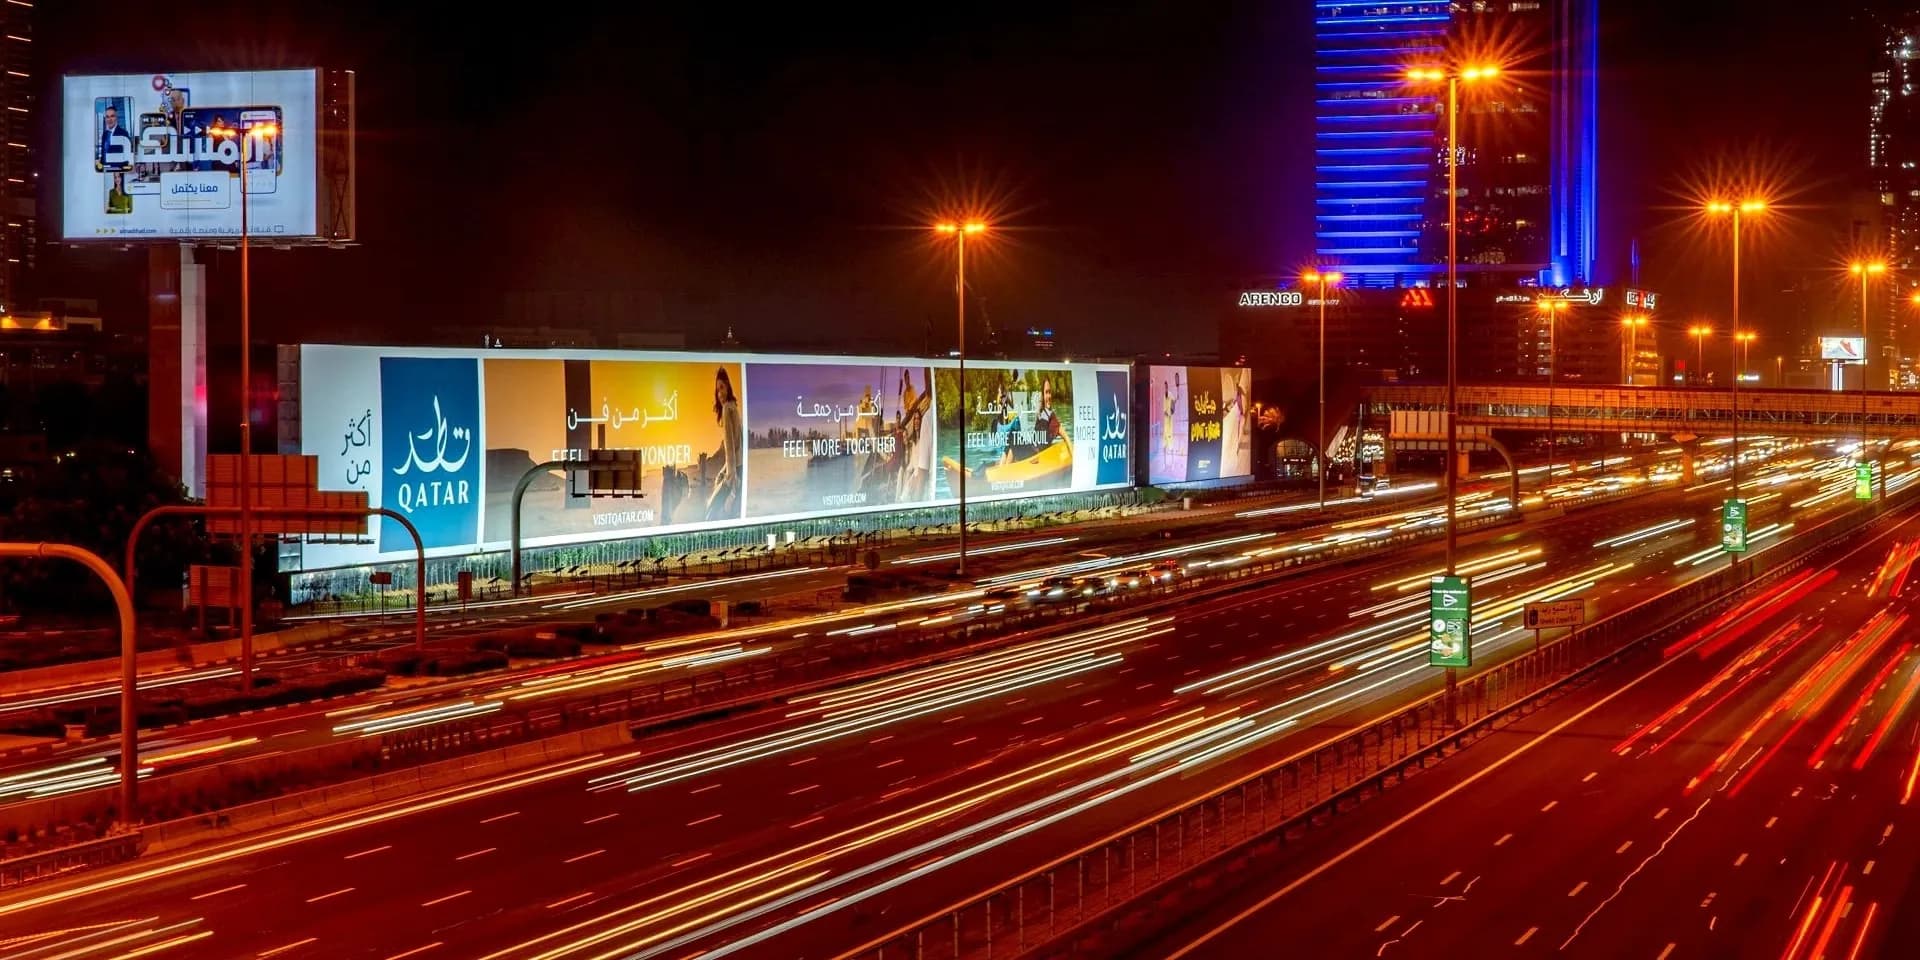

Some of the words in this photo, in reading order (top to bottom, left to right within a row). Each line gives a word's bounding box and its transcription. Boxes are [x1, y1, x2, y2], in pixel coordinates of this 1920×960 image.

[171, 181, 198, 195] يكتمل
[199, 183, 219, 193] معنا
[1239, 292, 1302, 306] ARENCO
[567, 397, 610, 430] فن
[612, 407, 639, 429] من
[641, 389, 679, 428] أكثر
[796, 395, 832, 424] جمعة
[834, 404, 854, 422] من
[1078, 405, 1097, 421] FEEL
[341, 409, 372, 456] أكثر
[392, 395, 471, 475] قطر
[967, 432, 986, 448] FEEL
[988, 430, 1010, 447] MORE
[1011, 430, 1049, 447] TRANQUIL
[1076, 425, 1097, 441] MORE
[783, 440, 808, 458] FEEL
[812, 438, 841, 456] MORE
[846, 436, 896, 455] TOGETHER
[1087, 446, 1096, 461] IN
[1102, 444, 1127, 463] QATAR
[346, 458, 372, 484] من
[398, 480, 470, 513] QATAR
[592, 509, 655, 527] VISITQATAR.COM
